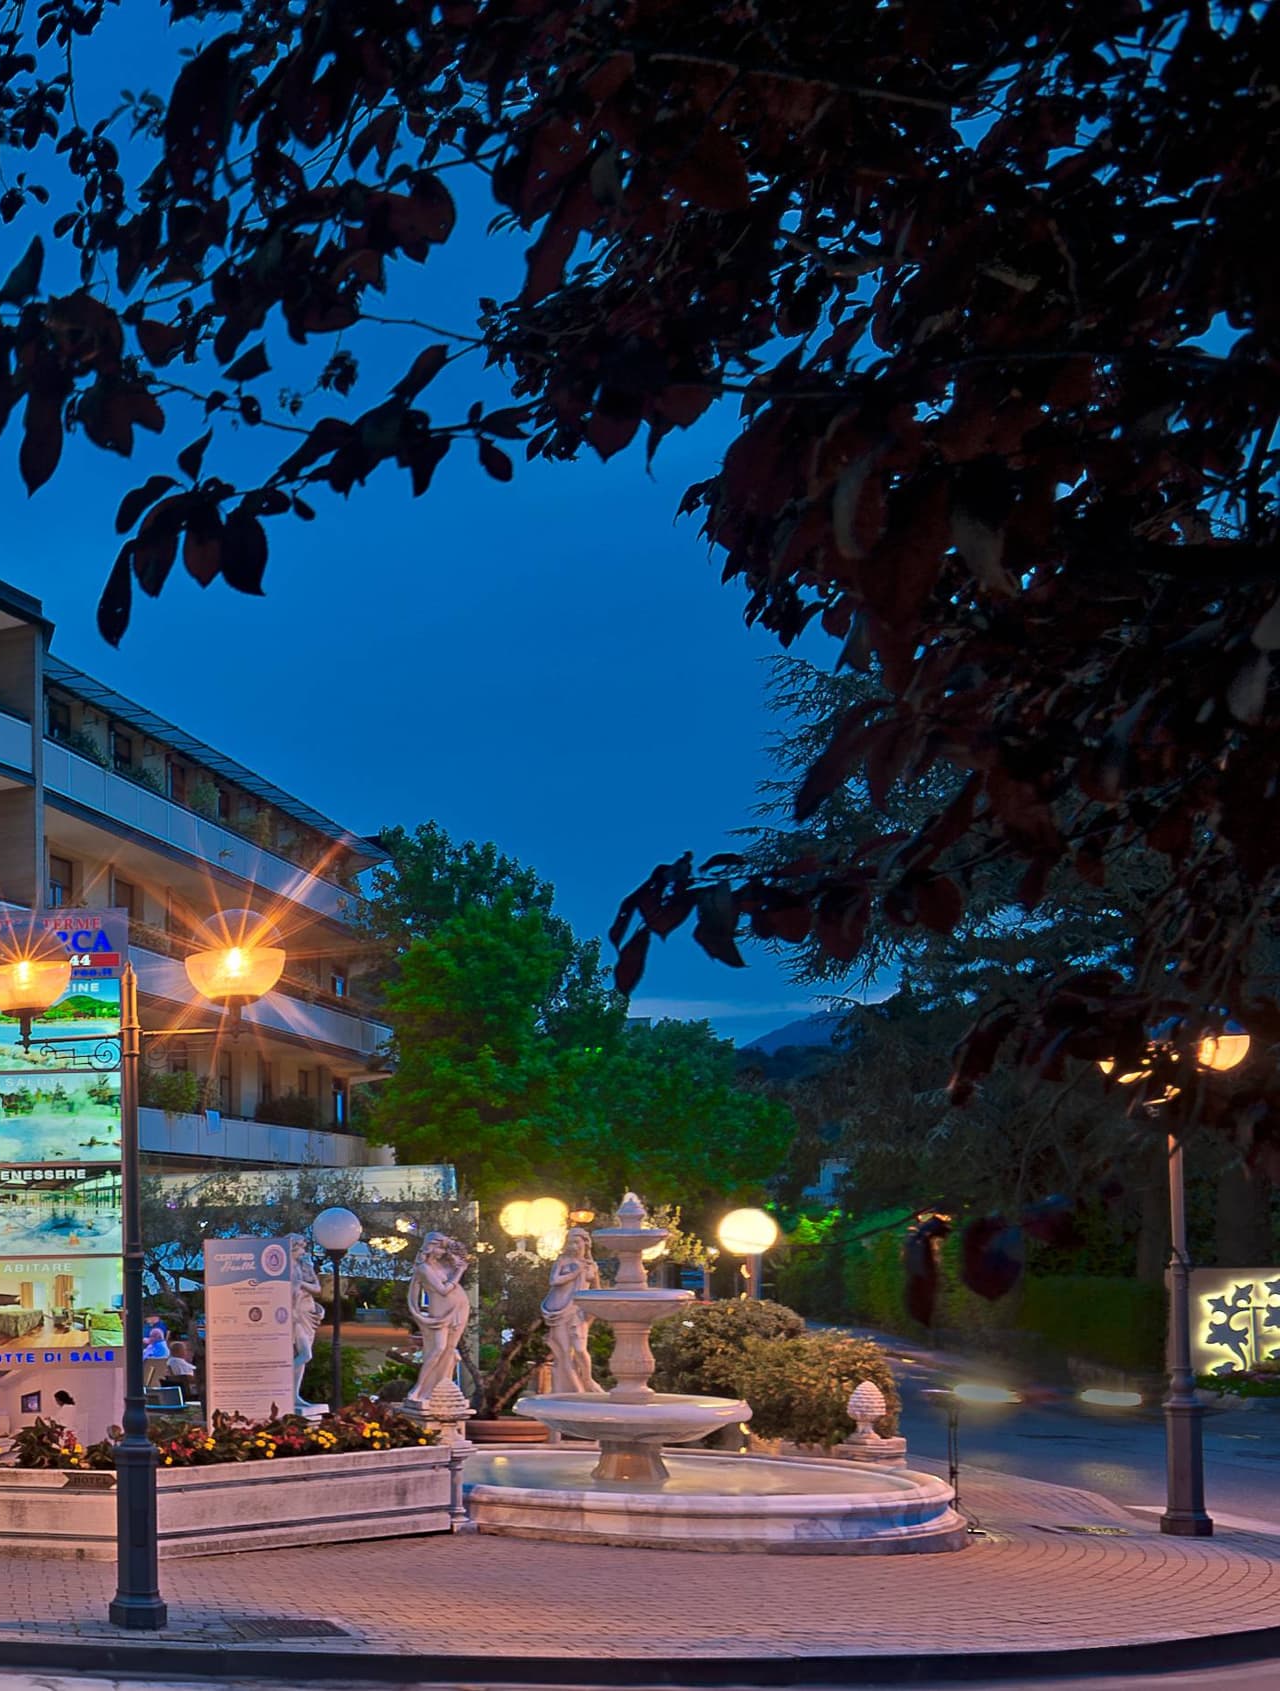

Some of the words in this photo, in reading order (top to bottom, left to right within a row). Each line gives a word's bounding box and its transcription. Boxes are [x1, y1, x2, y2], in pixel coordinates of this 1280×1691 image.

[3, 1262, 74, 1273] ABITARE
[44, 1352, 61, 1363] DI
[70, 1350, 115, 1363] SALE
